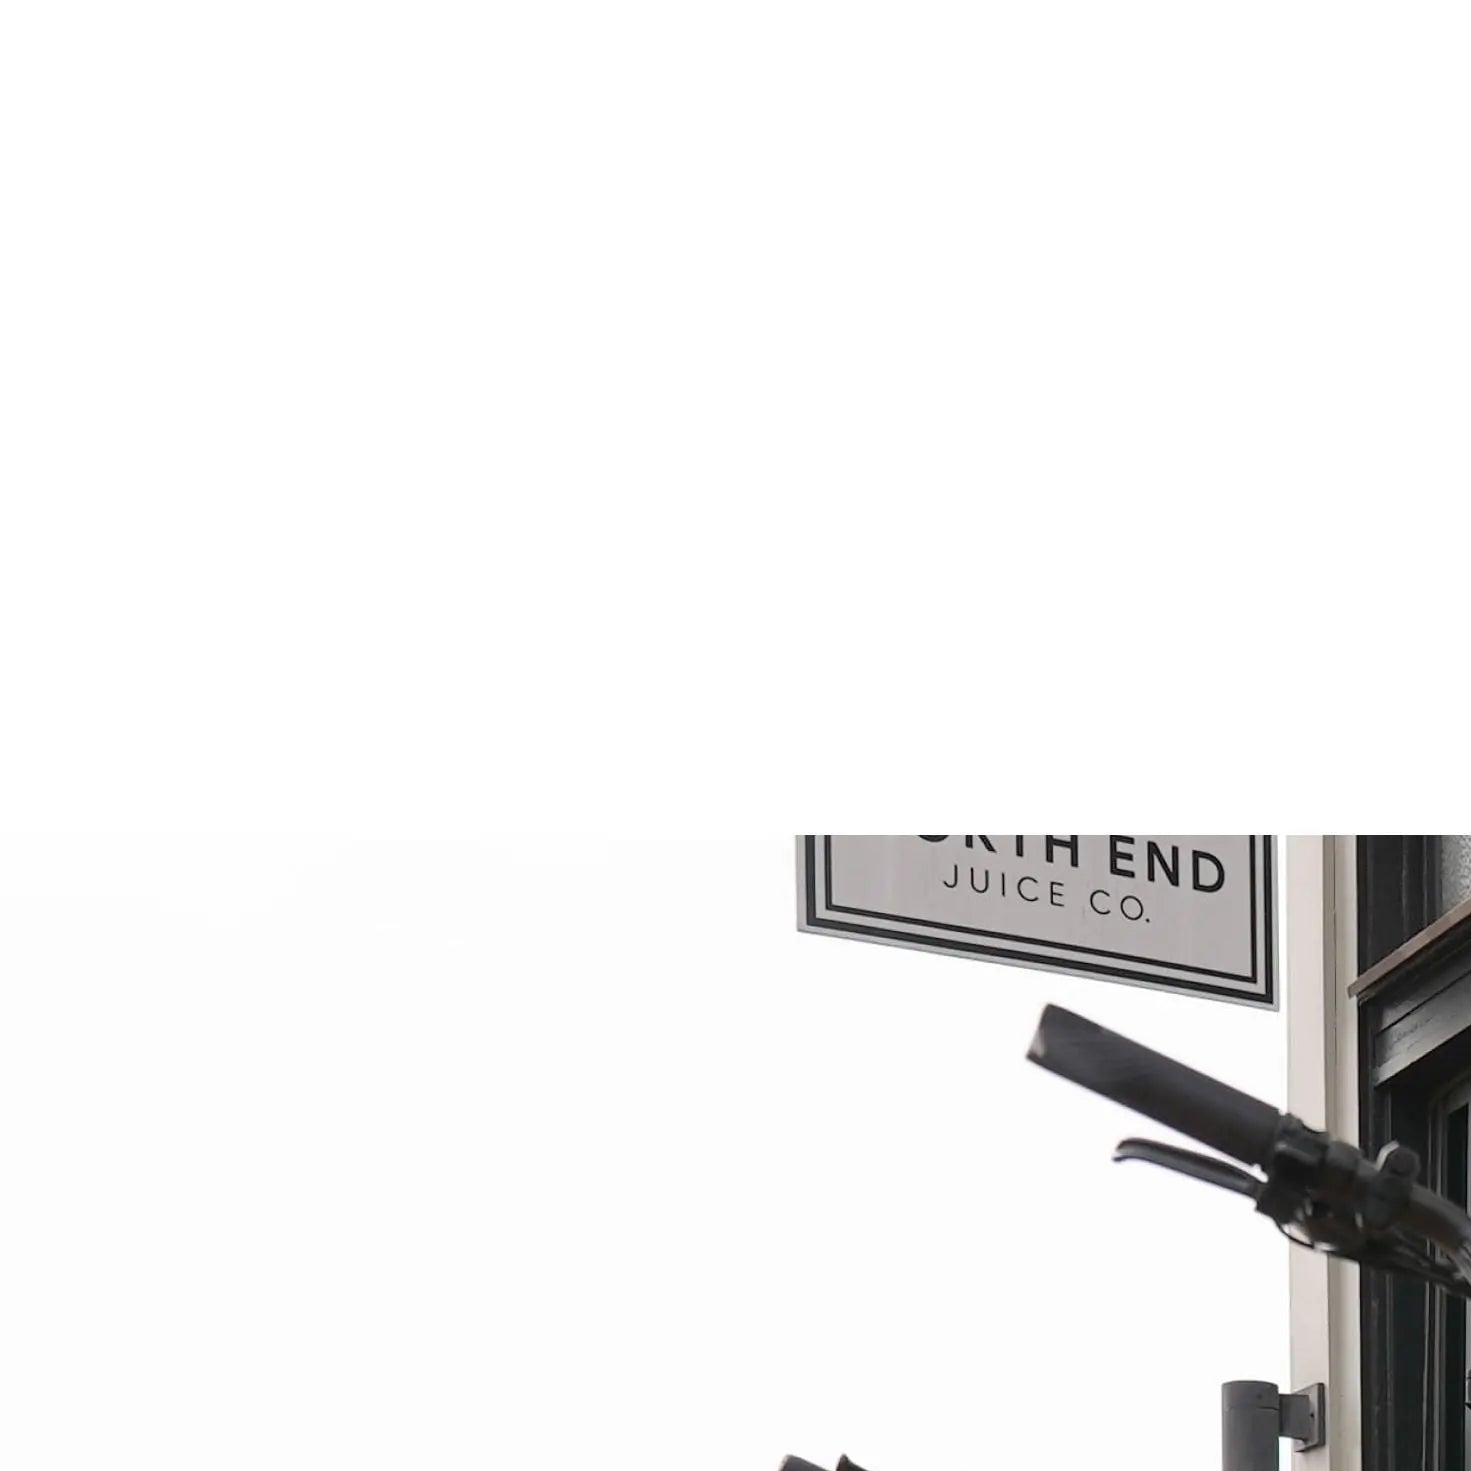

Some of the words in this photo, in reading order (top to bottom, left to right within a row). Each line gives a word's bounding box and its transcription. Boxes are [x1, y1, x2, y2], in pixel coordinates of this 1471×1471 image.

[943, 864, 1065, 908] JUICE
[1089, 889, 1151, 923] CO.
[1109, 836, 1226, 893] END
